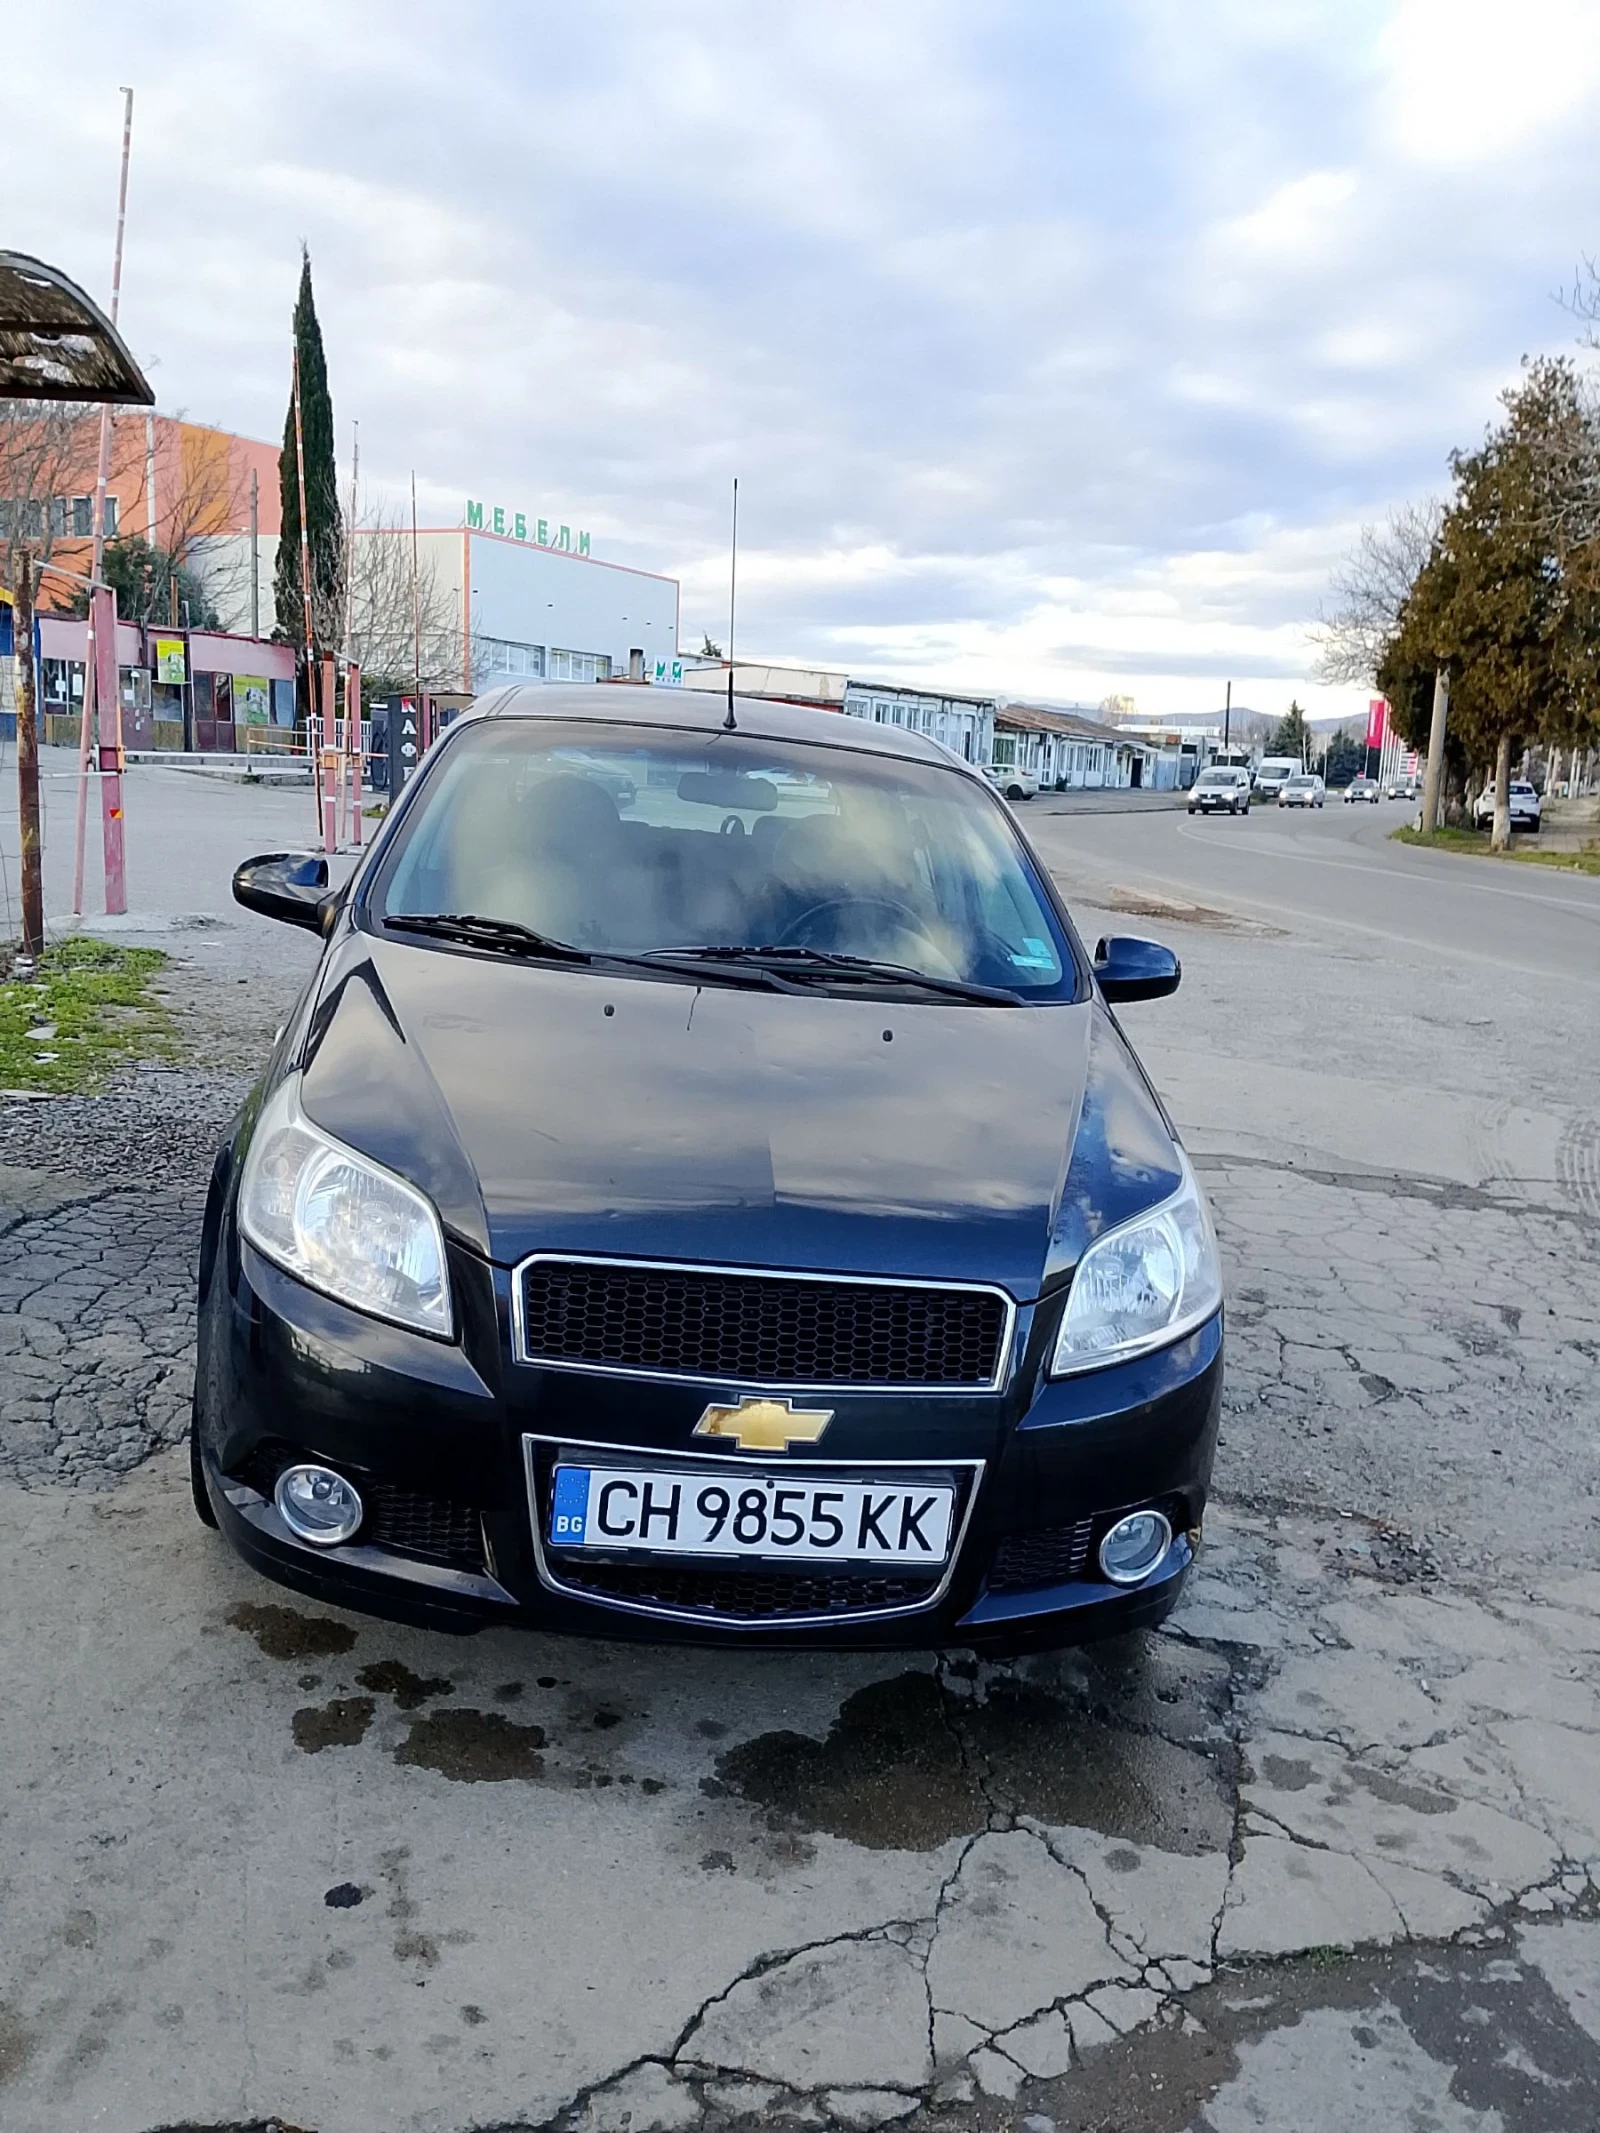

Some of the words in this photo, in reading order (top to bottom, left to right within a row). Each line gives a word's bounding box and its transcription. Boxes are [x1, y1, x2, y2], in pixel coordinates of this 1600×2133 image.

[466, 499, 592, 556] МЕБЕЛИ
[556, 1515, 583, 1533] BG
[597, 1480, 682, 1541] CH
[696, 1486, 844, 1548] 9855
[857, 1494, 938, 1552] KK
